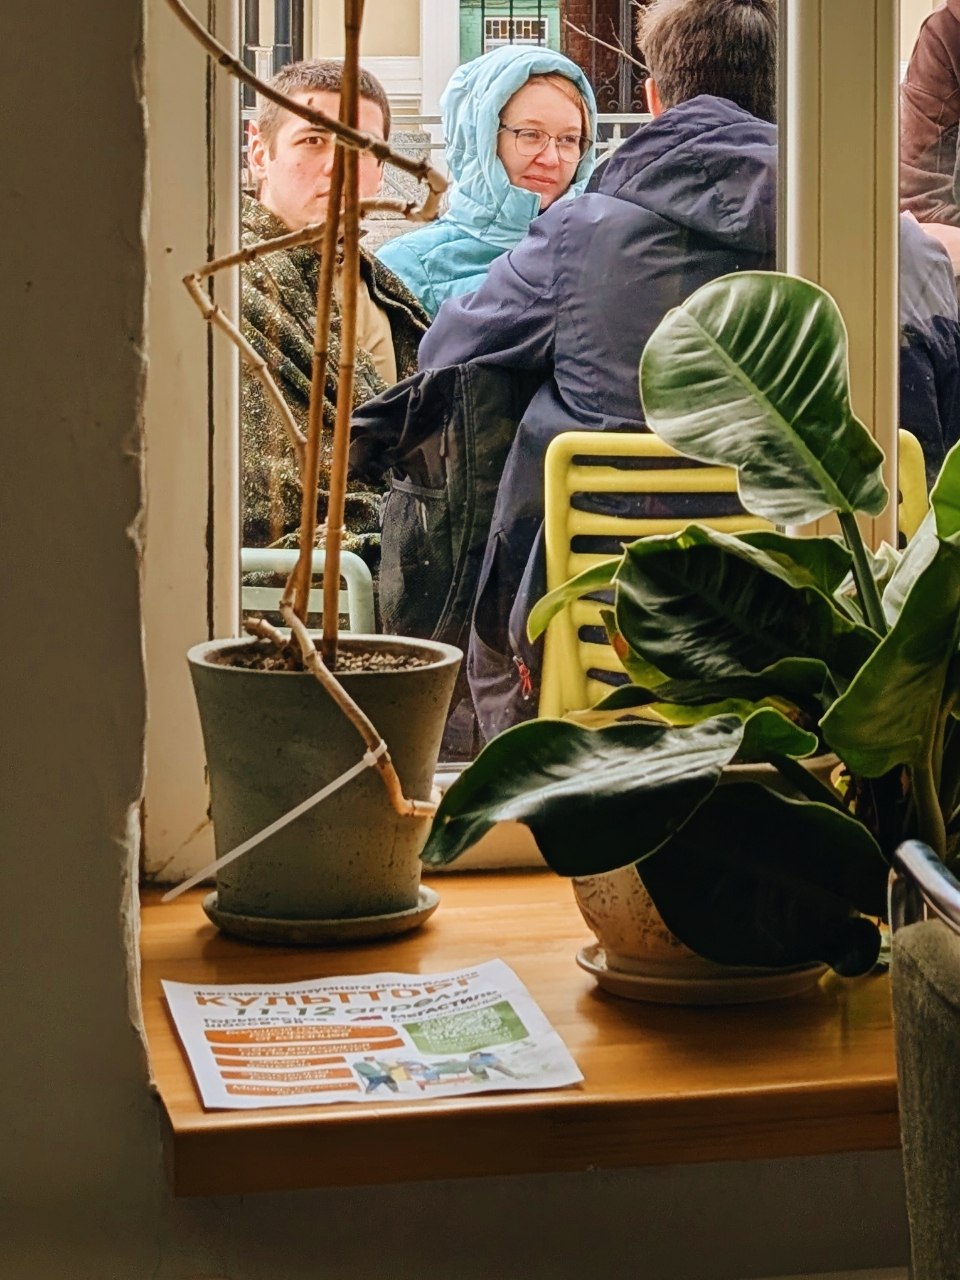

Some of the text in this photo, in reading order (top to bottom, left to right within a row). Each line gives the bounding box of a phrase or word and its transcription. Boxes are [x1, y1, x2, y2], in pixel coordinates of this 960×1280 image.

[195, 974, 481, 1007] КУЛЬТТОРГ
[235, 1006, 337, 1016] 11-12
[345, 989, 469, 1014] апреля
